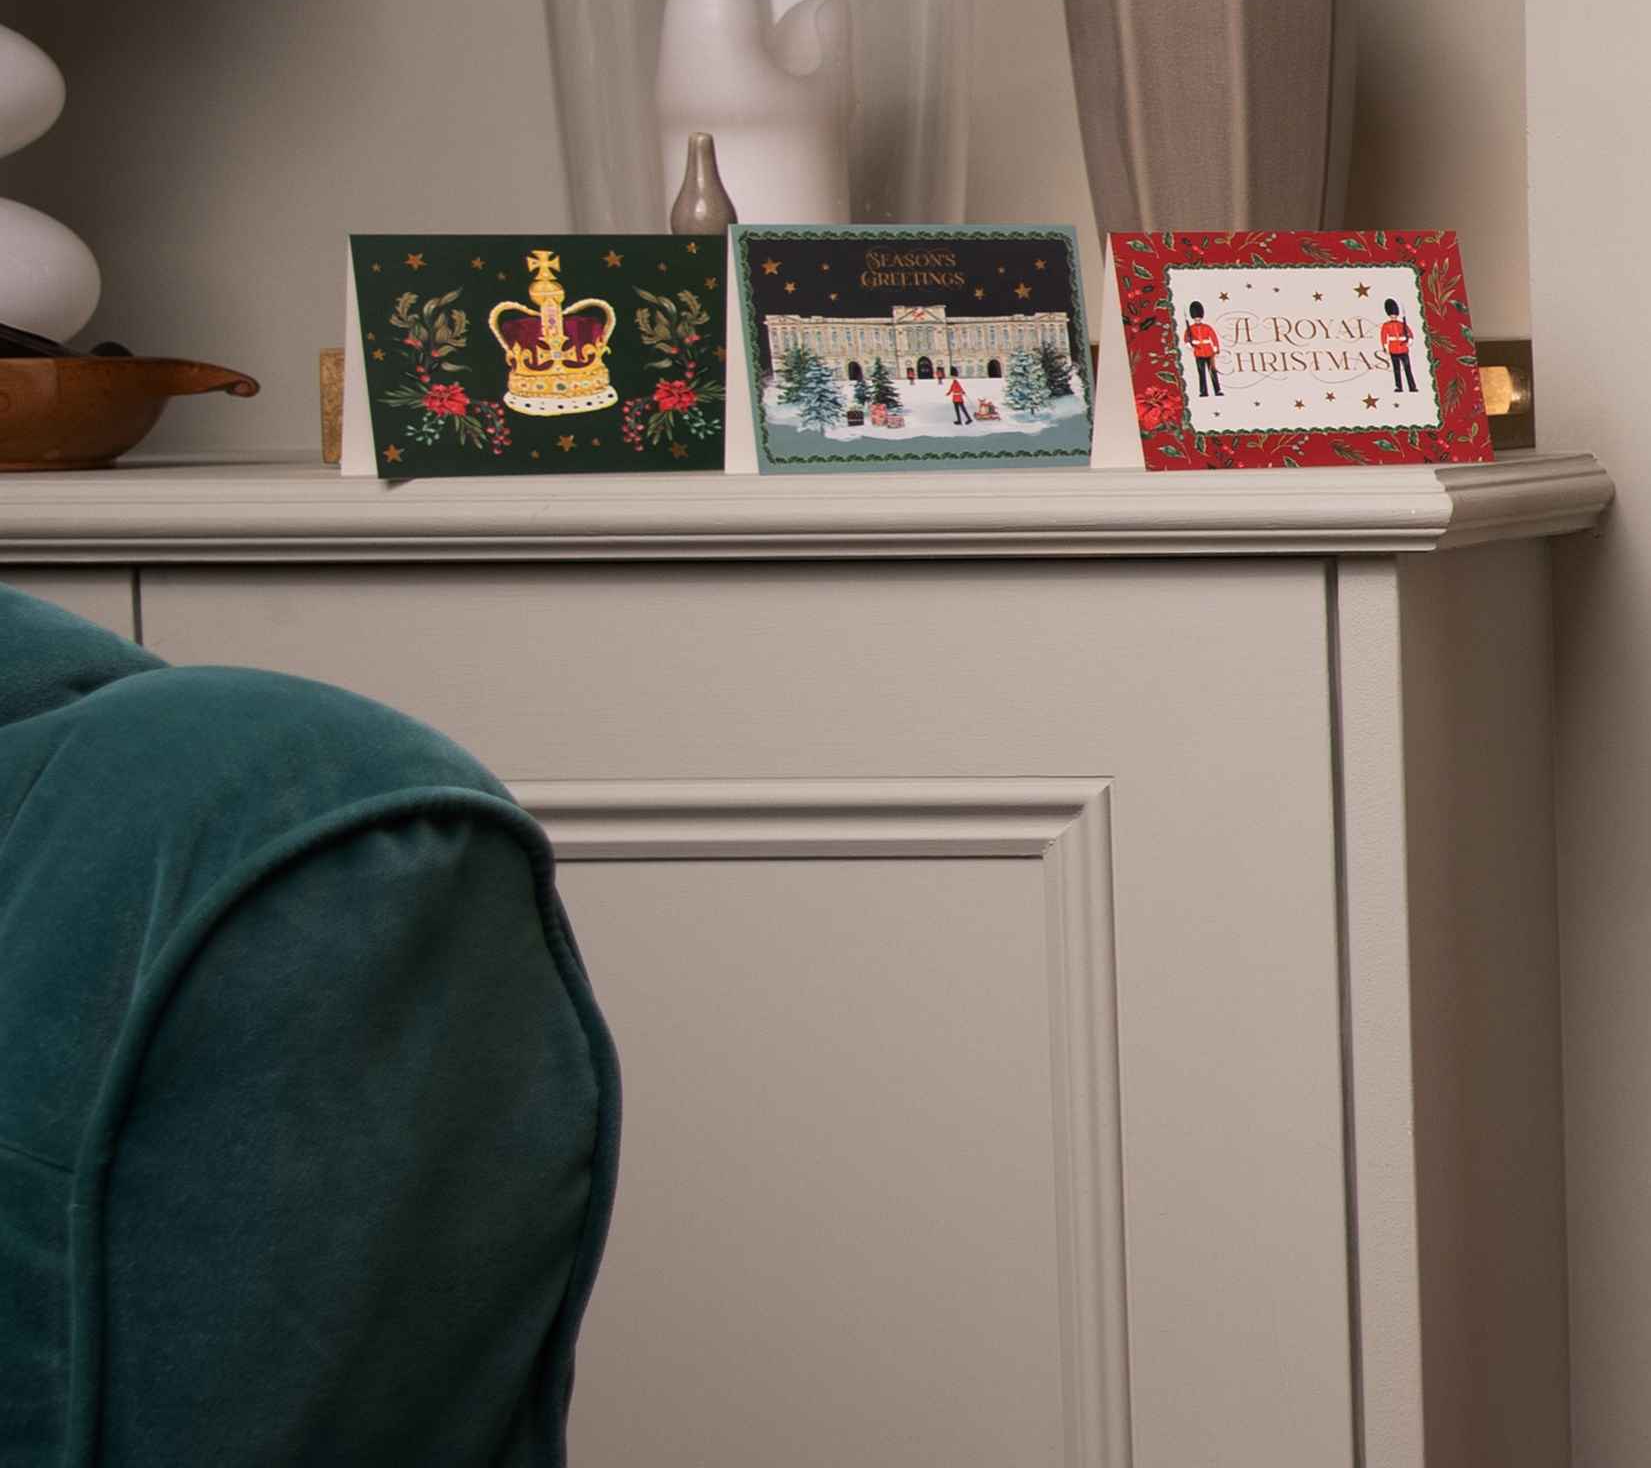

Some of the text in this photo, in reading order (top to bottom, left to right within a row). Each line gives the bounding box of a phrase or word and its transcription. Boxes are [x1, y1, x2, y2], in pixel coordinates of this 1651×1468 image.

[860, 270, 967, 288] GREETINGS
[1263, 315, 1374, 346] ROYAL
[1217, 349, 1390, 377] CHRISTMAS
